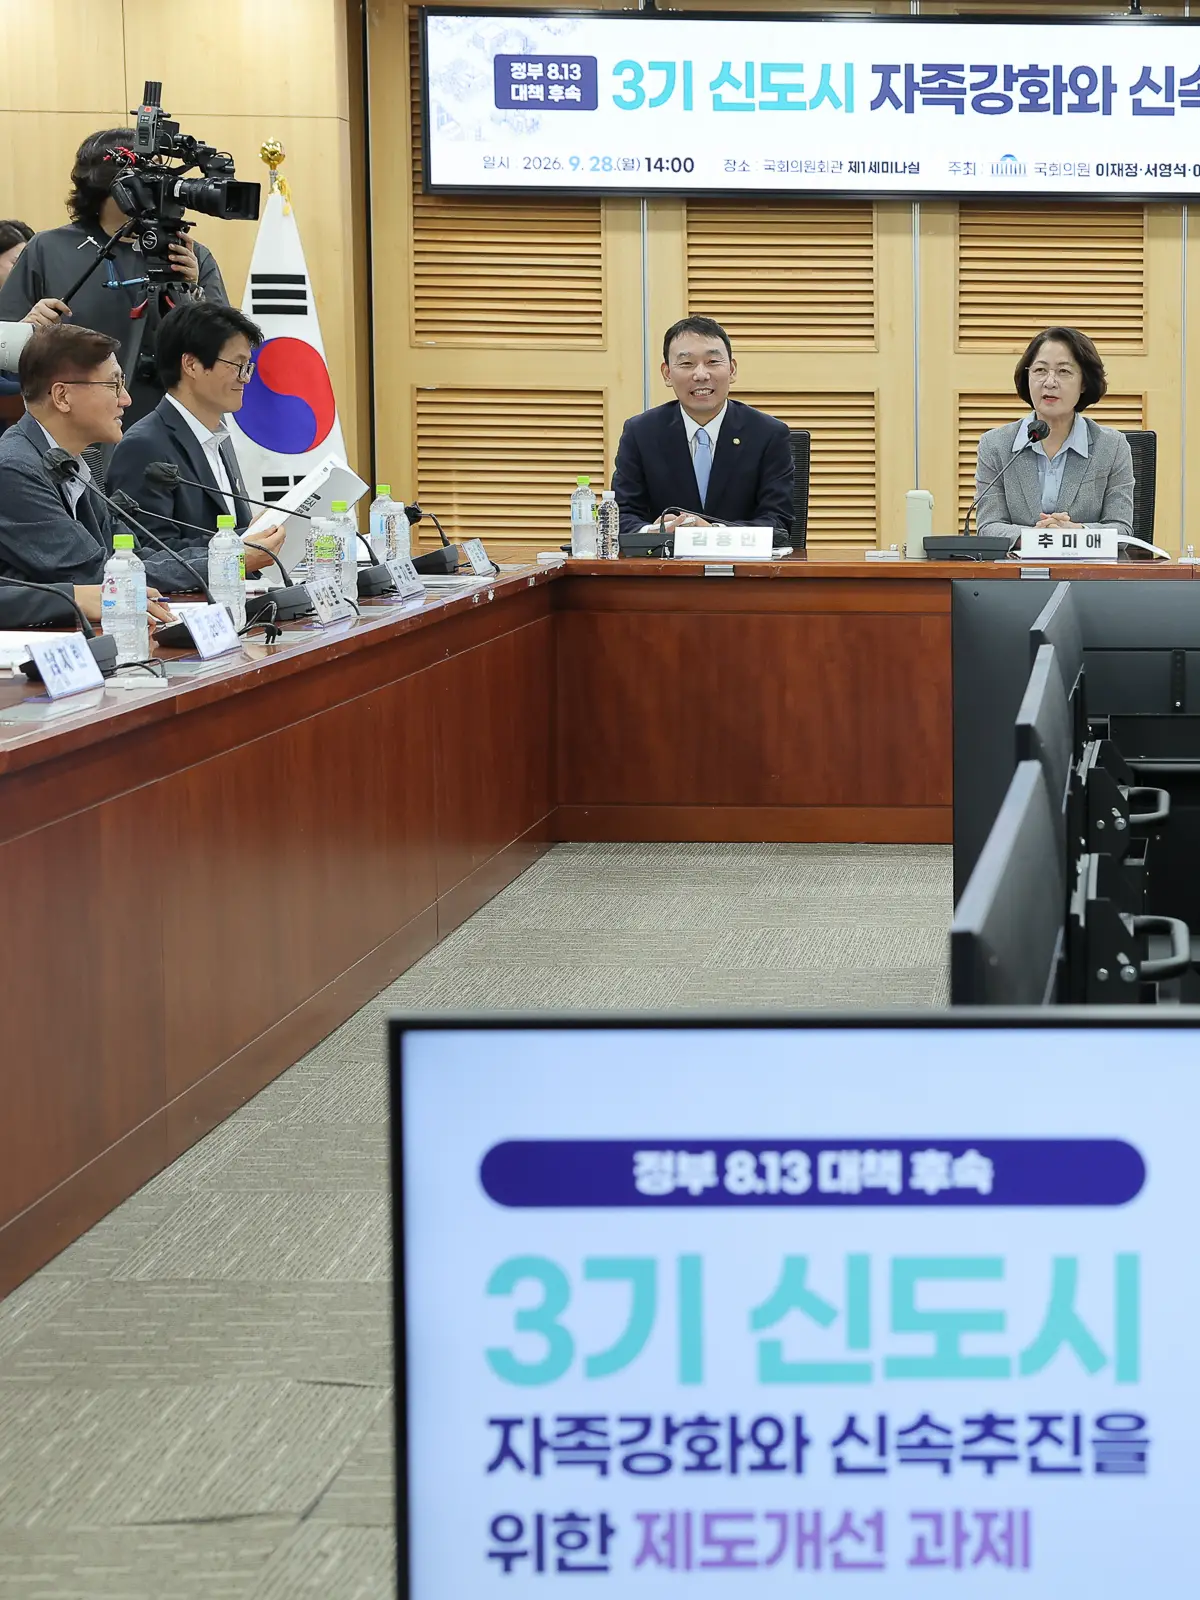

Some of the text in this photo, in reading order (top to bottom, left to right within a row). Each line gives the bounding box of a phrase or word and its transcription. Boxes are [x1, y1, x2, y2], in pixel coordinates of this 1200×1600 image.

[510, 61, 582, 81] 정부 8.13
[510, 83, 582, 103] 대책 후속
[612, 59, 693, 112] 3기
[709, 61, 855, 114] 신도시
[870, 63, 1118, 116] 자족강화와
[523, 156, 564, 170] 2026.
[645, 157, 695, 173] 14:00
[763, 159, 844, 174] 국회의원회관
[848, 160, 920, 175] 제1세미나실
[1034, 162, 1090, 177] 국회의원
[1038, 533, 1102, 549] 추미애
[632, 1148, 995, 1196] 정부 8.13 대책 후속
[485, 1252, 1141, 1388] 3기 신도시
[486, 1411, 1151, 1479] 자족강화와 신속추진을
[486, 1510, 1030, 1575] 위한 제도개선 과제
